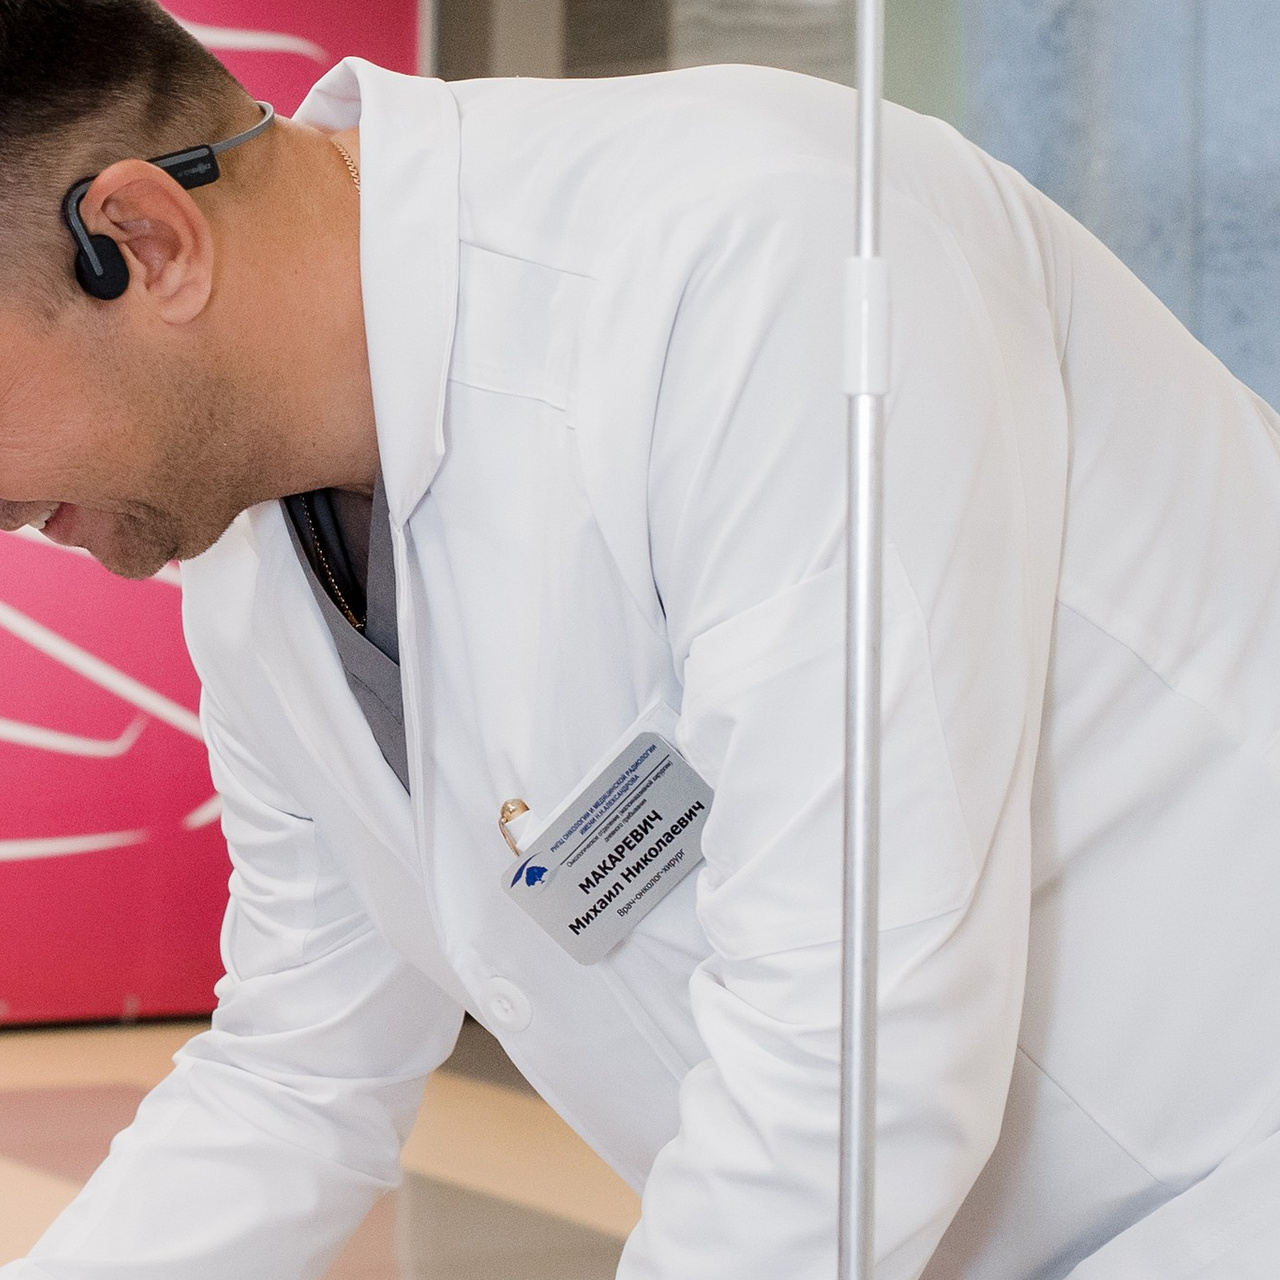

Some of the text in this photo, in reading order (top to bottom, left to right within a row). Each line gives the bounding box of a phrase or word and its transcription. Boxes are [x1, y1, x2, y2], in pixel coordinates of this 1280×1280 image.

[561, 810, 592, 841] ОНКОЛОГИИ
[591, 773, 628, 810] МЕДИЦИНСКОЙ
[624, 743, 657, 777] РАДИОЛОГИИ
[578, 816, 597, 836] ИМЕНИ
[567, 800, 705, 936] Михаил Николаевич
[577, 809, 663, 895] МАКАРЕВИЧ
[616, 847, 685, 917] Врач-онколог-хирург
